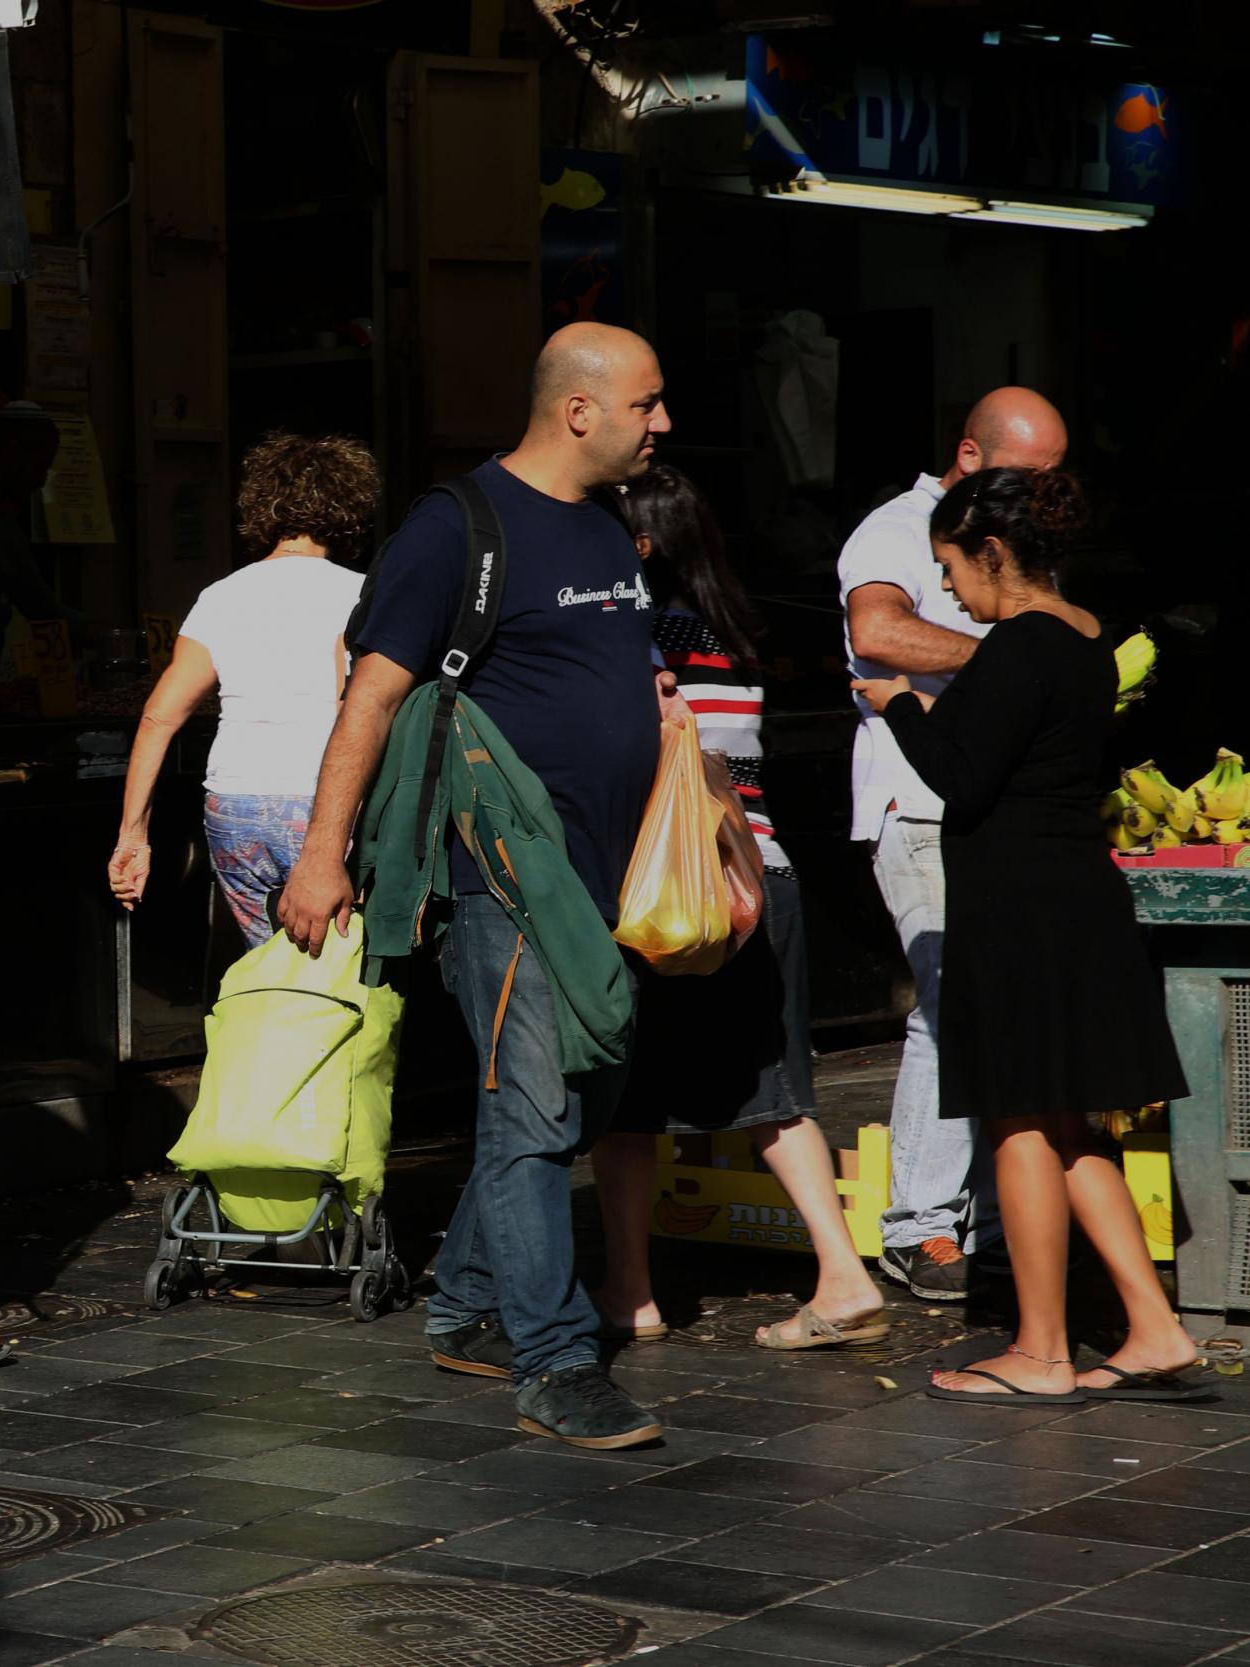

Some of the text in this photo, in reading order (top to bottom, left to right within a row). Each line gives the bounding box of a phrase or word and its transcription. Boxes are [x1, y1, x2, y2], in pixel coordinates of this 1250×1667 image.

[853, 64, 974, 181] דגים
[475, 551, 494, 615] DAKINE
[557, 581, 639, 607] Business Class
[729, 1203, 806, 1227] ננות
[731, 1229, 812, 1247] יכות
